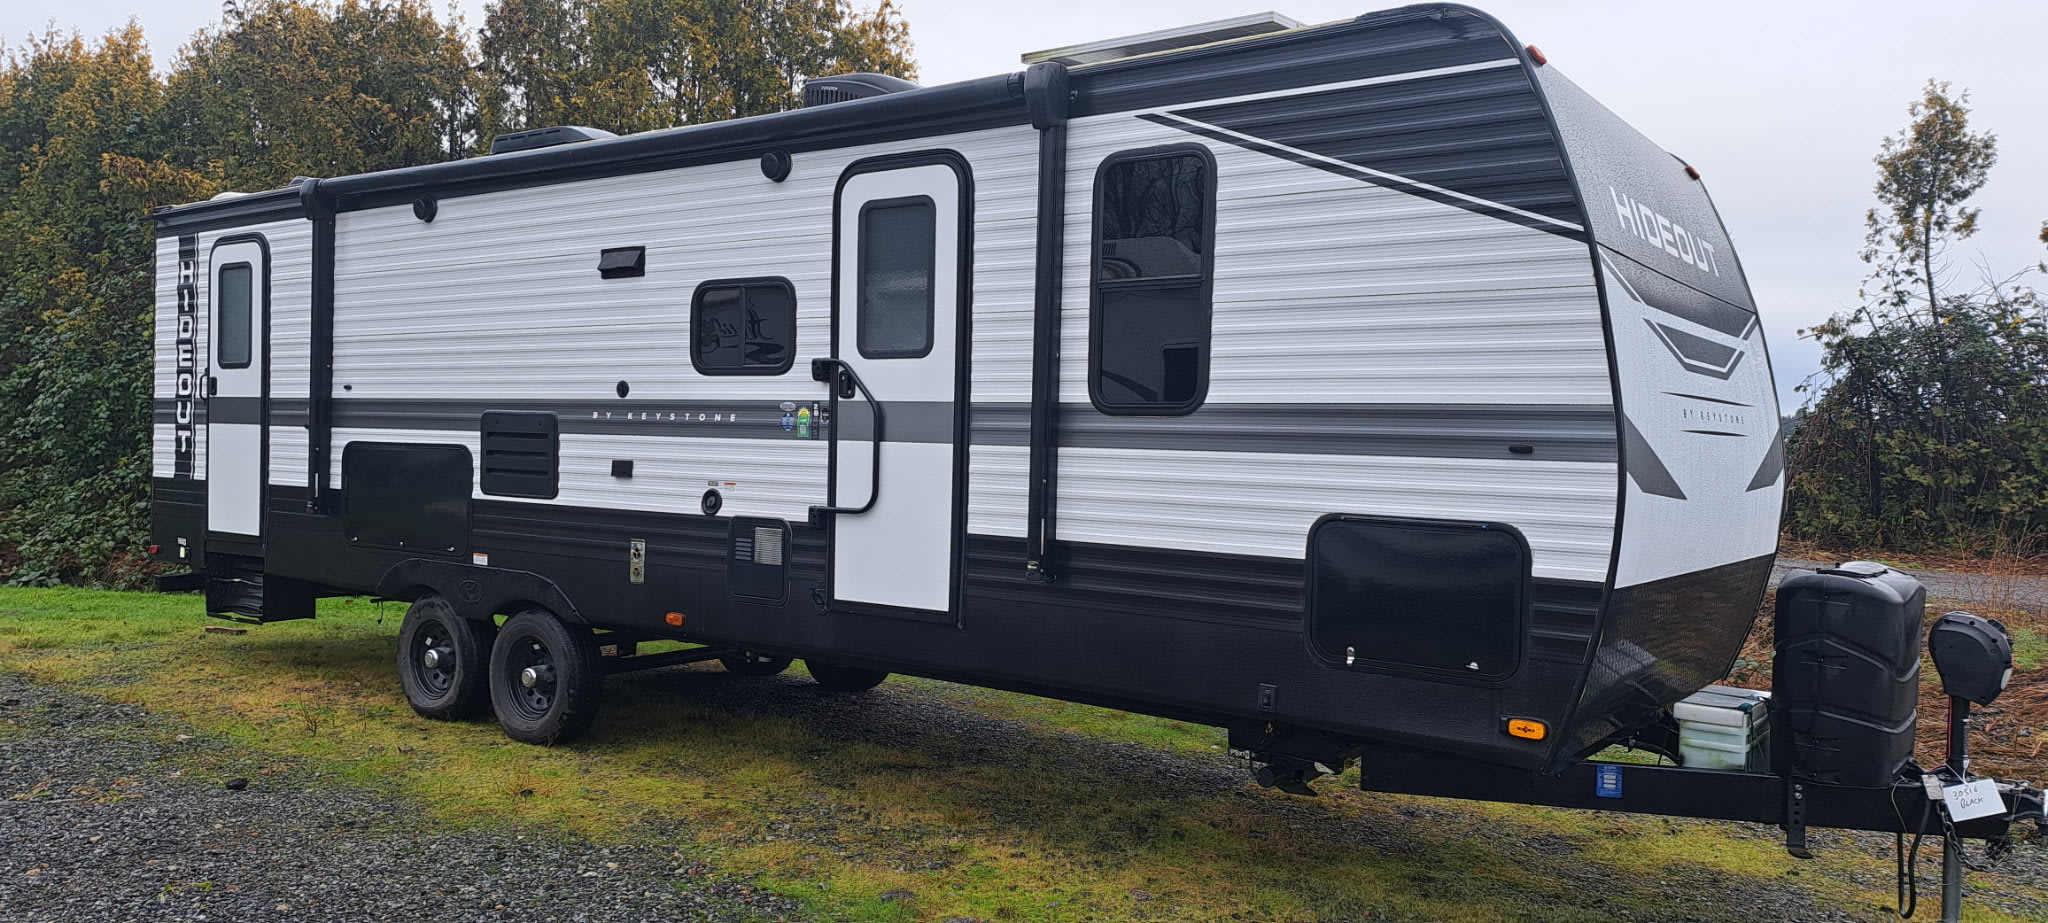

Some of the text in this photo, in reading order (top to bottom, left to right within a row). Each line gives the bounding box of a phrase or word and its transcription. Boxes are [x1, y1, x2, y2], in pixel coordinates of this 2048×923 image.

[1609, 185, 1720, 278] HIDEOUT
[176, 260, 194, 453] HIDEOUT
[592, 411, 737, 422] BY KEYSTONE
[1683, 408, 1745, 425] BY KEYSTONE
[1960, 797, 1984, 809] BLACK
